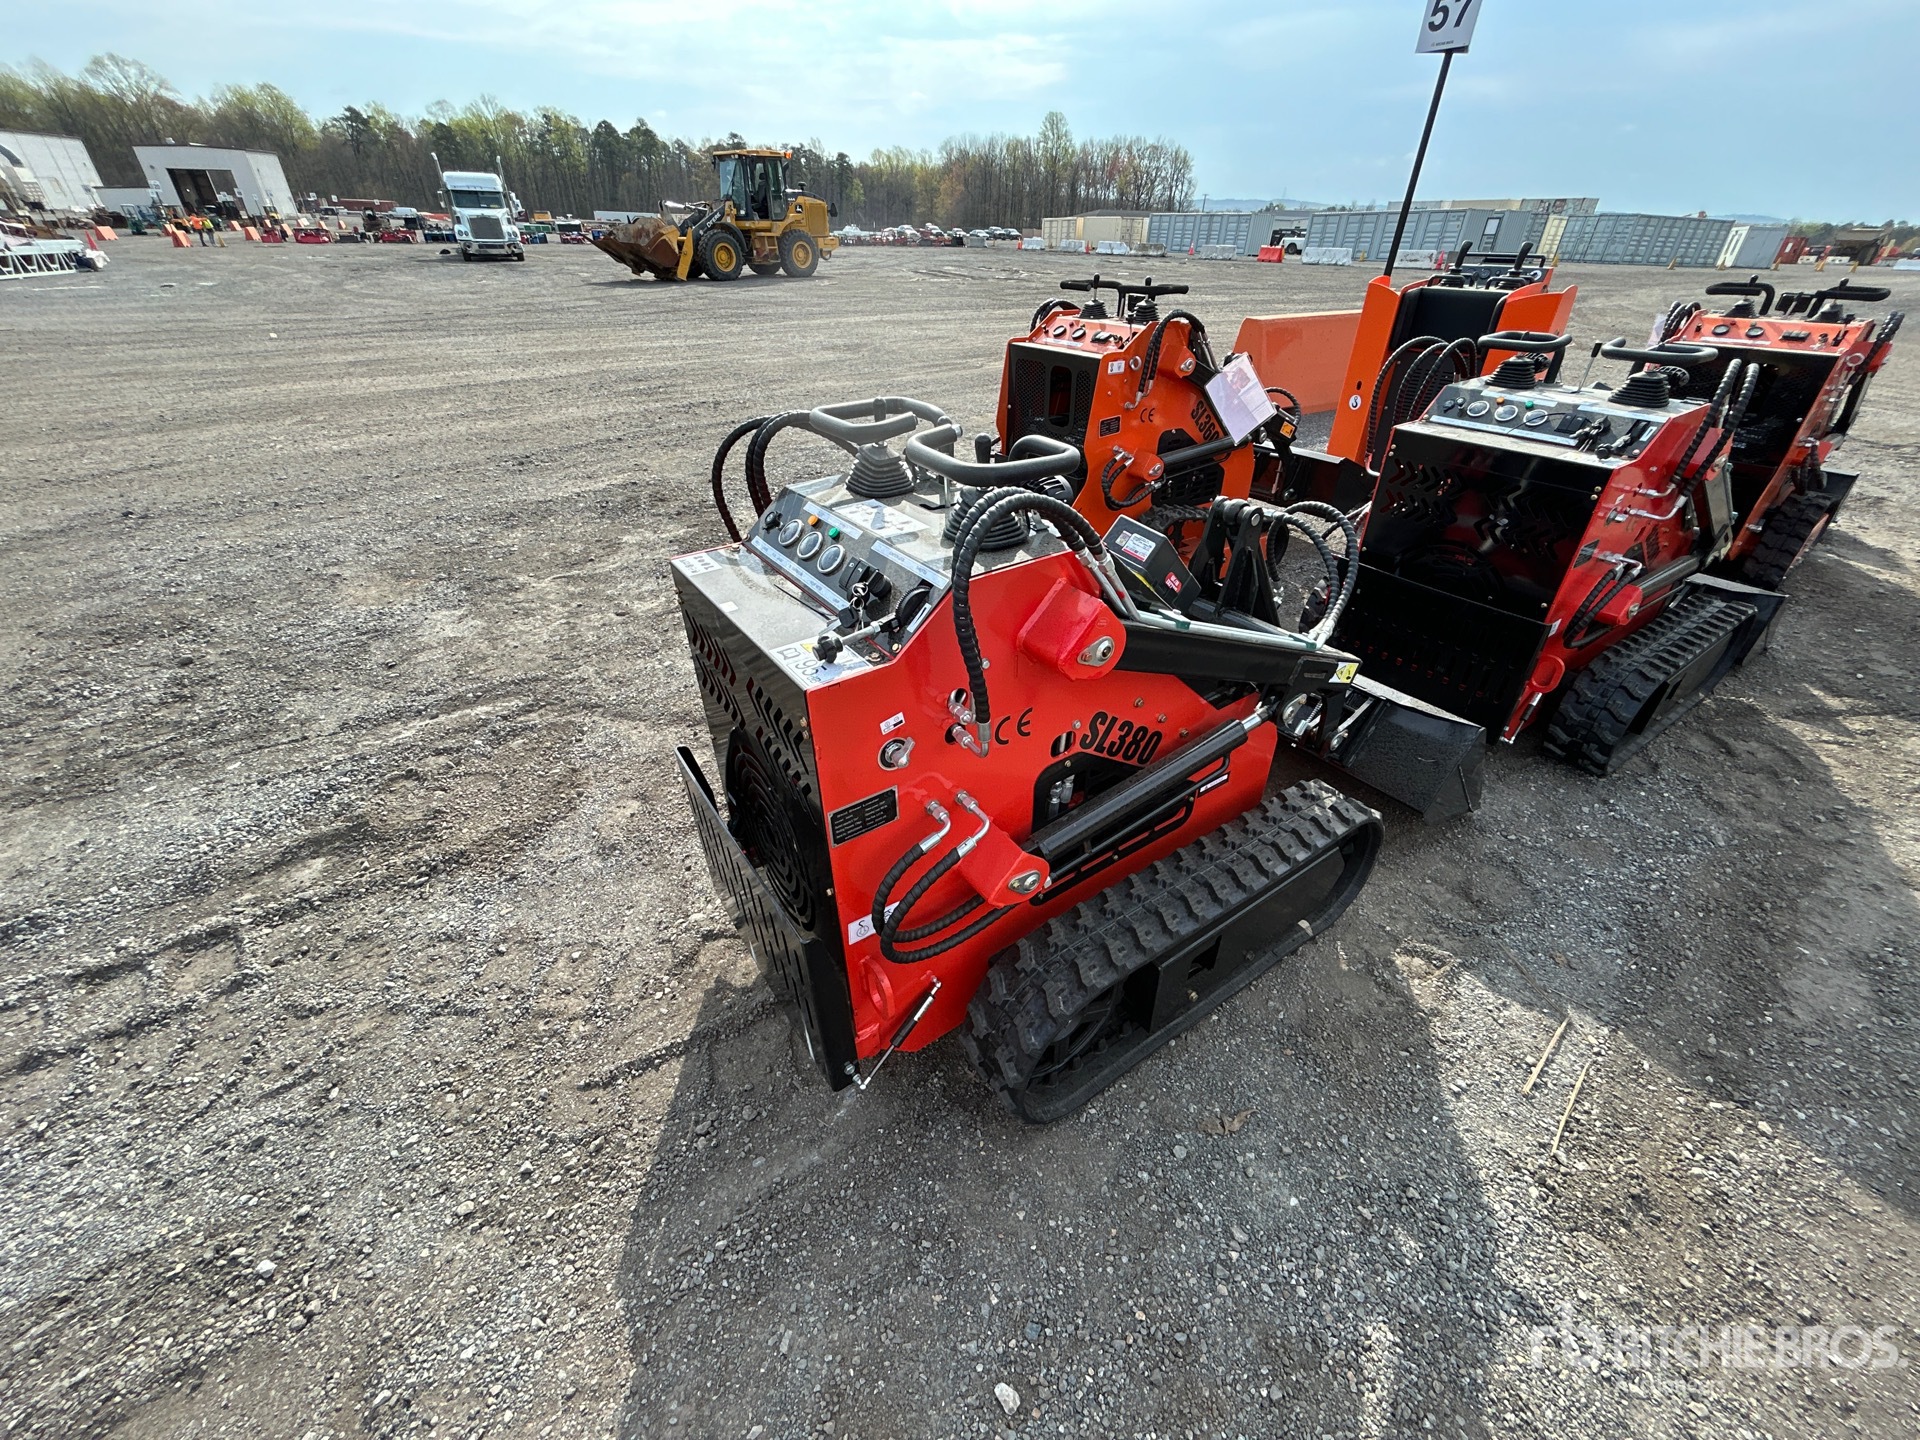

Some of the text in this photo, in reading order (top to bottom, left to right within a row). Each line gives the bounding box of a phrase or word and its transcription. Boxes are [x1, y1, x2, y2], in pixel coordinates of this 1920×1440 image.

[1428, 0, 1472, 32] 57
[1140, 407, 1156, 423] CE
[994, 707, 1034, 746] CE
[1079, 711, 1163, 765] SL380
